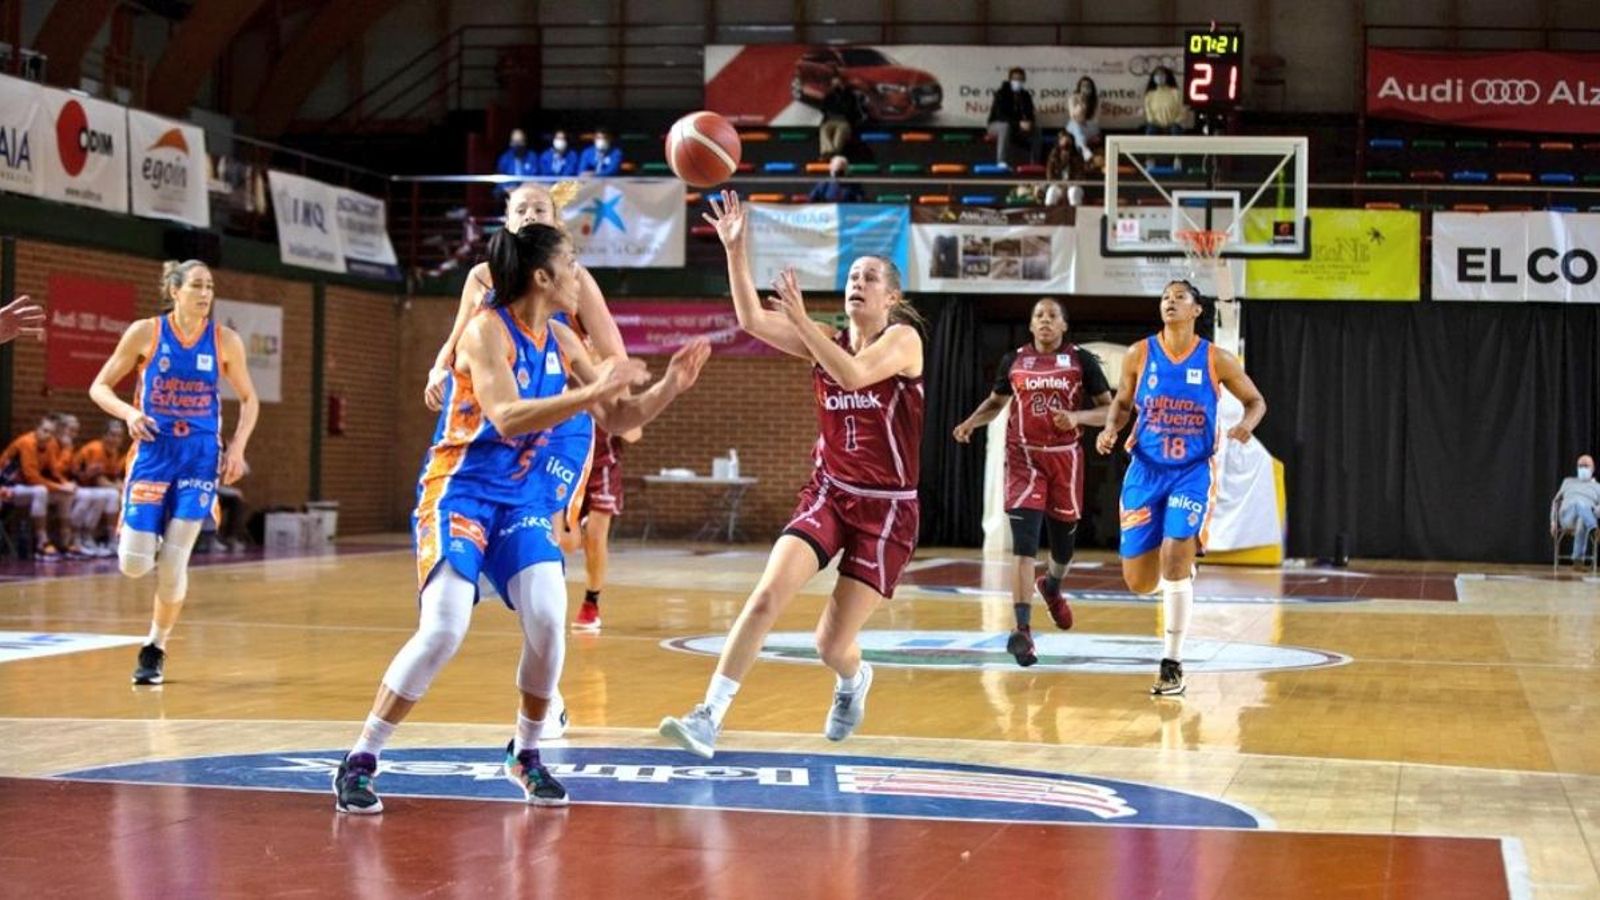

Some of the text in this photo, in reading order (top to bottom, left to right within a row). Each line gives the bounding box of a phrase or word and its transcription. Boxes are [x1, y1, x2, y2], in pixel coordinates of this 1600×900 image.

[1190, 35, 1238, 53] 07:21
[960, 86, 981, 97] De
[1040, 88, 1067, 101] por
[1189, 63, 1237, 101] 21
[1378, 76, 1463, 104] Audi
[142, 155, 188, 189] egoin
[1457, 247, 1598, 286] EL CO
[1024, 378, 1071, 391] lointek
[1031, 391, 1063, 417] 24
[1144, 394, 1194, 411] Cultura
[845, 415, 858, 452] 1
[1161, 436, 1186, 460] 18
[511, 449, 536, 481] 5
[546, 455, 575, 485] ika
